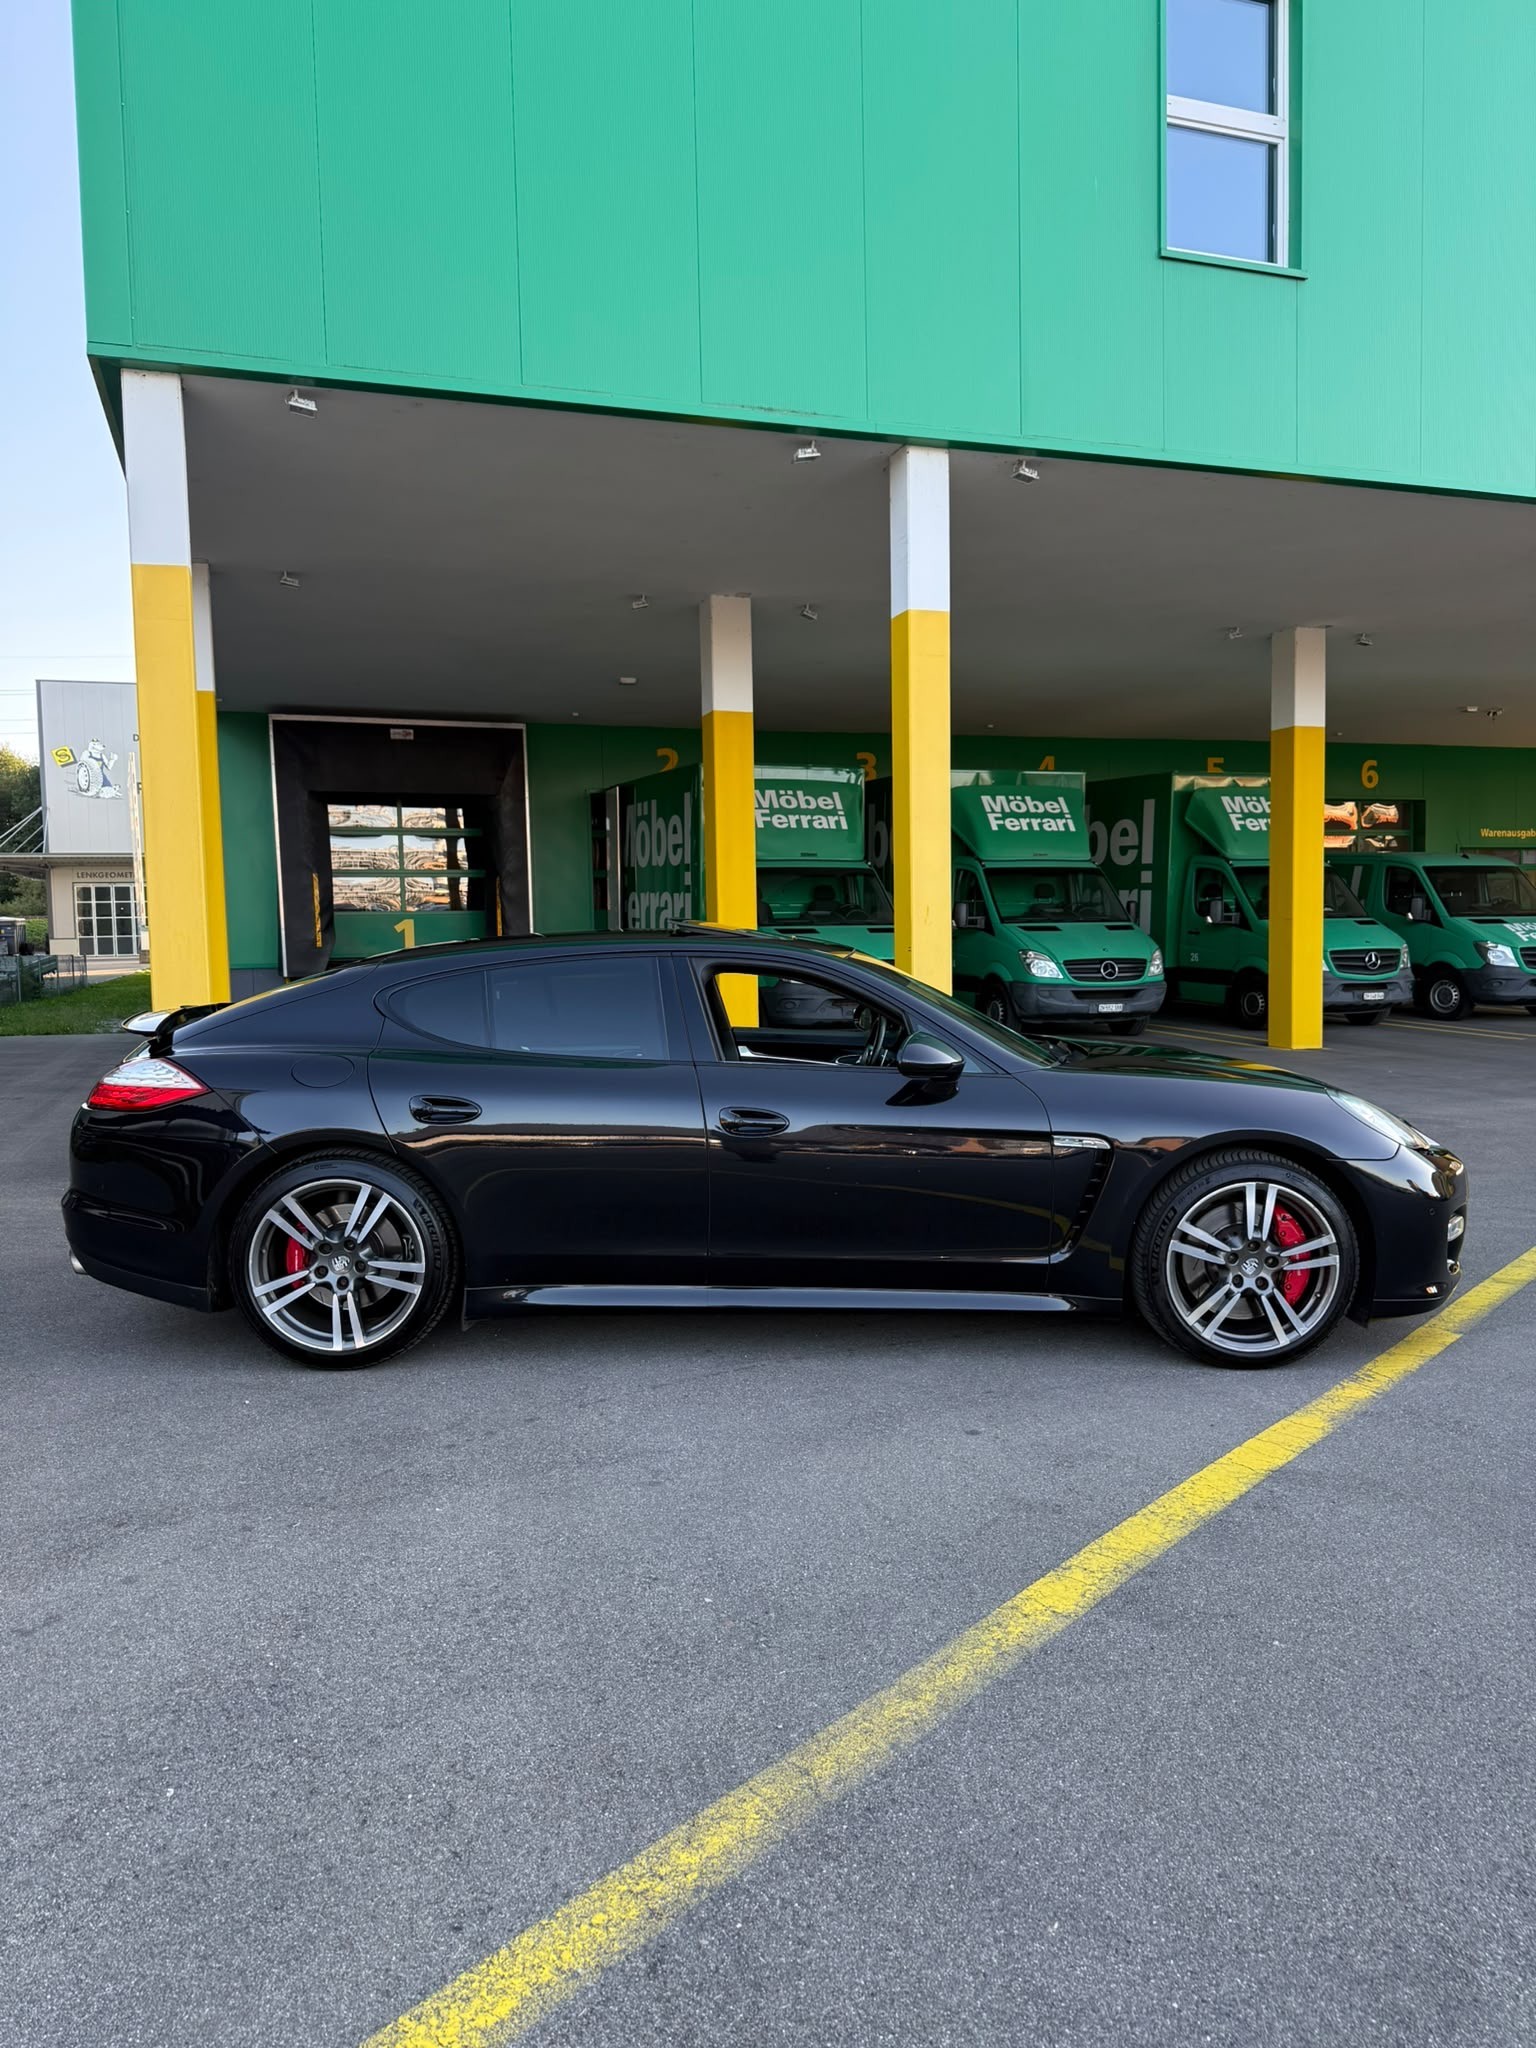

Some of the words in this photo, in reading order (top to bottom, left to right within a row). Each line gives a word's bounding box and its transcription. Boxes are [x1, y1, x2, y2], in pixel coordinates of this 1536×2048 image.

[856, 752, 877, 781] 3
[1361, 760, 1379, 789] 6
[754, 789, 843, 810] Möbel
[980, 795, 1069, 813] Möbel
[755, 809, 848, 830] Ferrari
[986, 813, 1076, 832] Ferrari
[76, 871, 135, 879] LENKGEOMET
[627, 872, 691, 931] errari
[393, 919, 415, 949] 1
